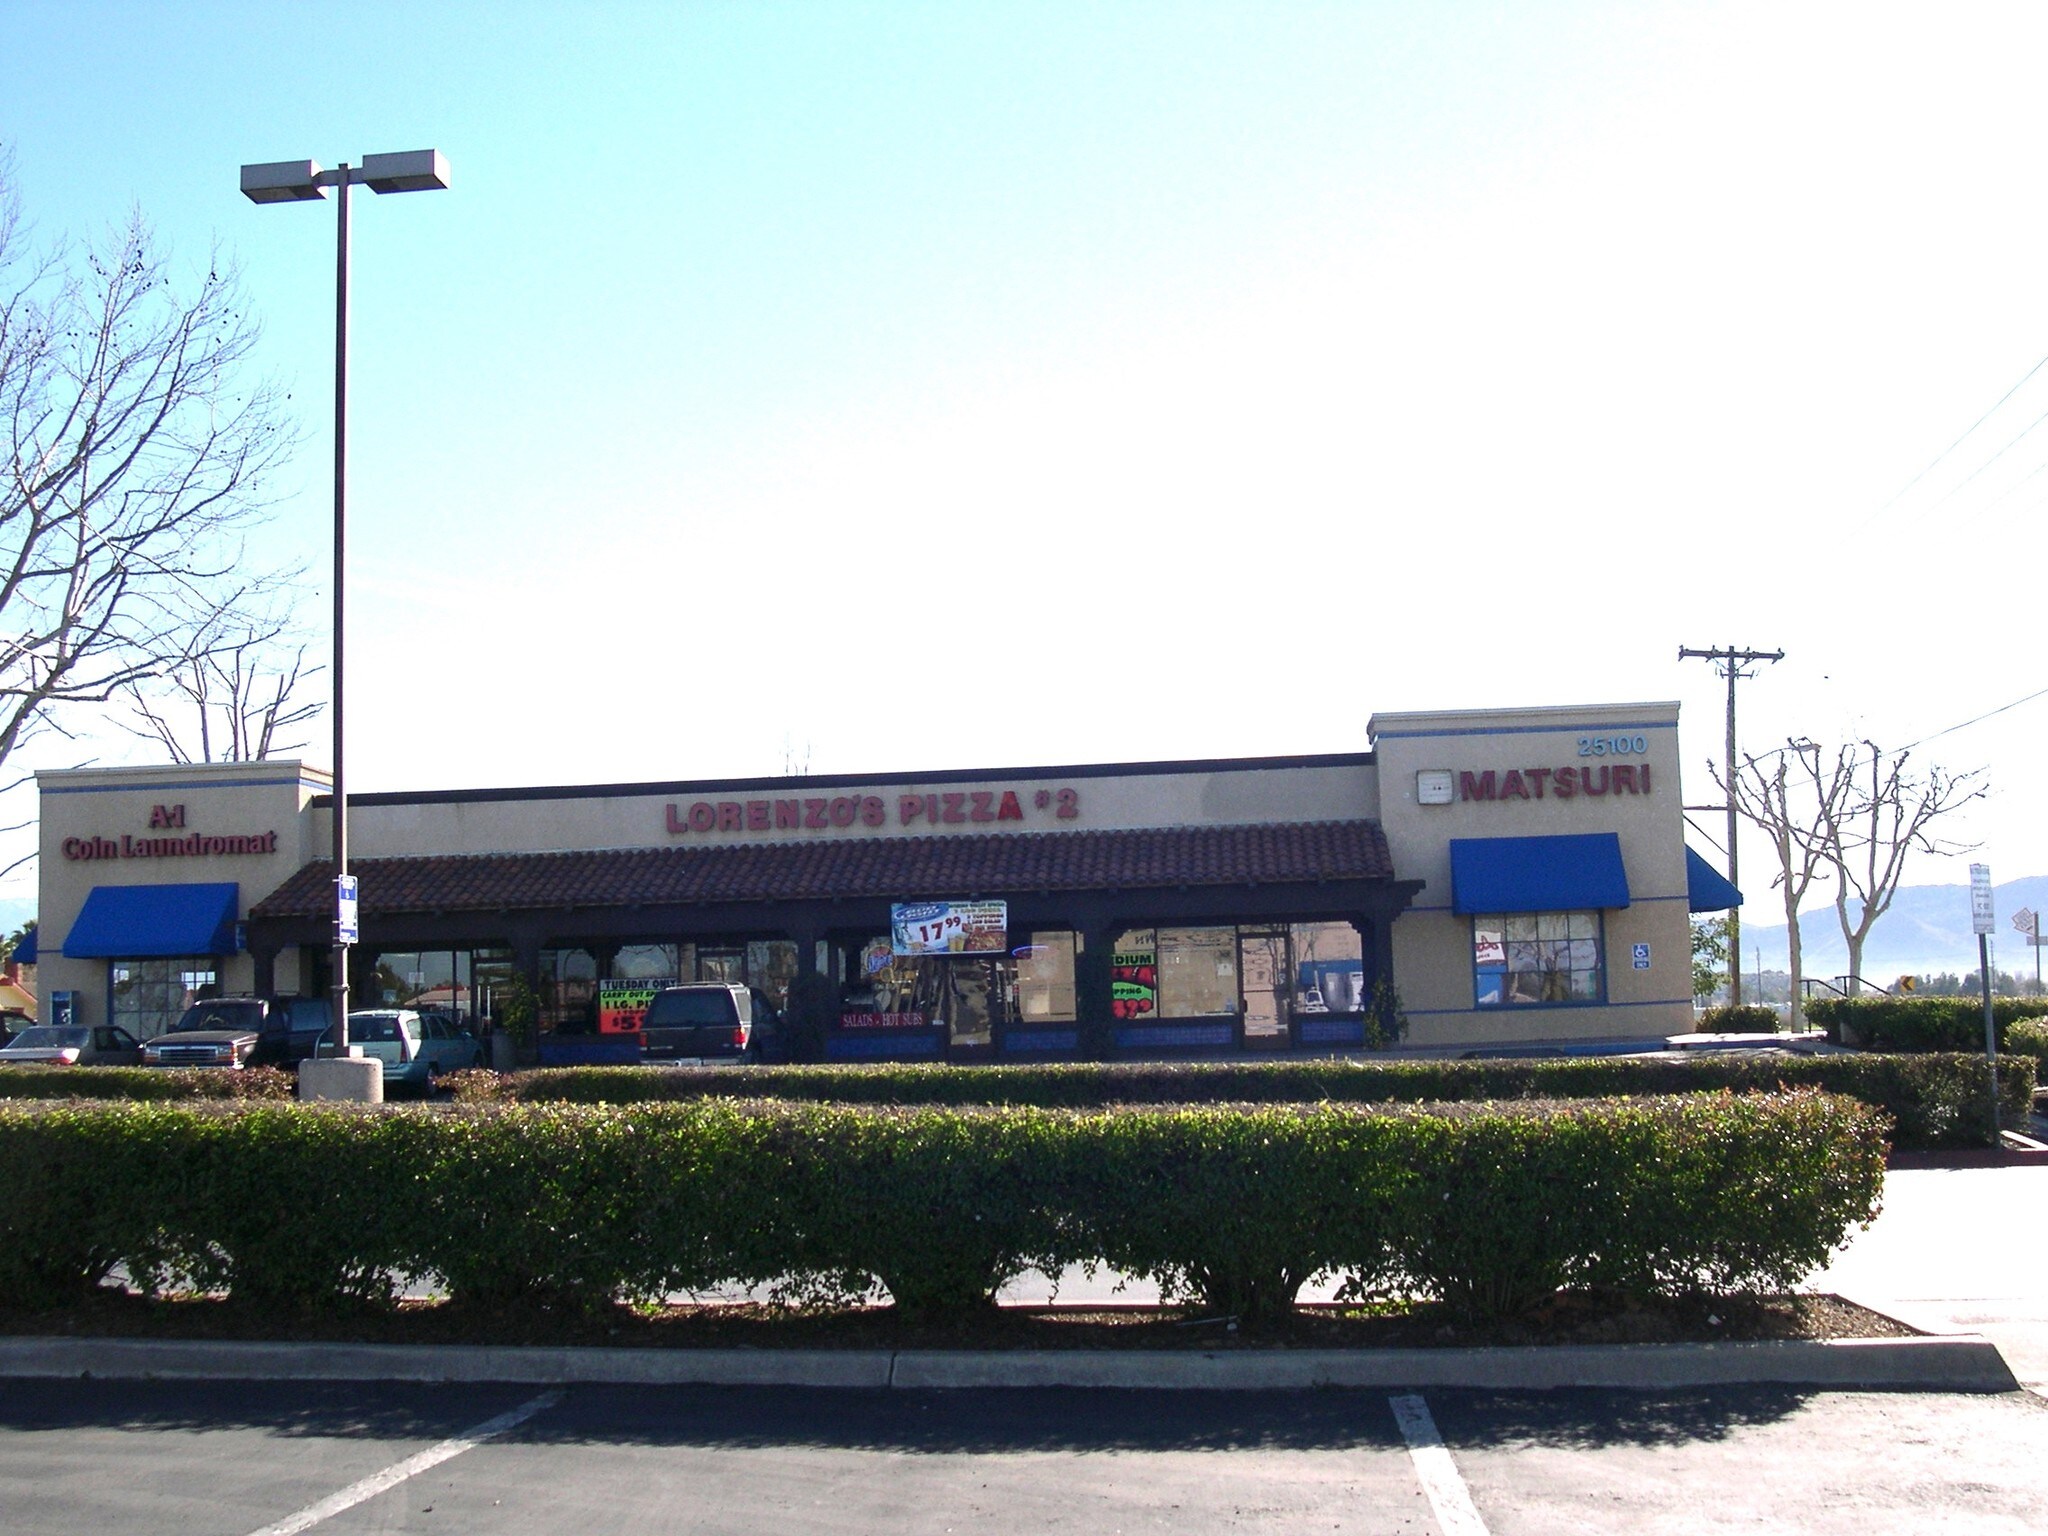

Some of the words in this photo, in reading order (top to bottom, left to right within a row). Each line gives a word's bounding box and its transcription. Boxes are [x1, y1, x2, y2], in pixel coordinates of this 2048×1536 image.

[1578, 735, 1648, 756] 25100
[1460, 764, 1651, 801] MATSURI
[666, 794, 886, 834] LORENZO'S
[899, 791, 1023, 827] PIZZA
[61, 836, 117, 860] Coin
[120, 830, 277, 858] Laundromat
[605, 980, 649, 989] TUESDAY
[652, 979, 677, 988] ONLY
[843, 1014, 873, 1027] SALADS
[882, 1013, 900, 1027] HOT
[903, 1012, 923, 1026] SUBS
